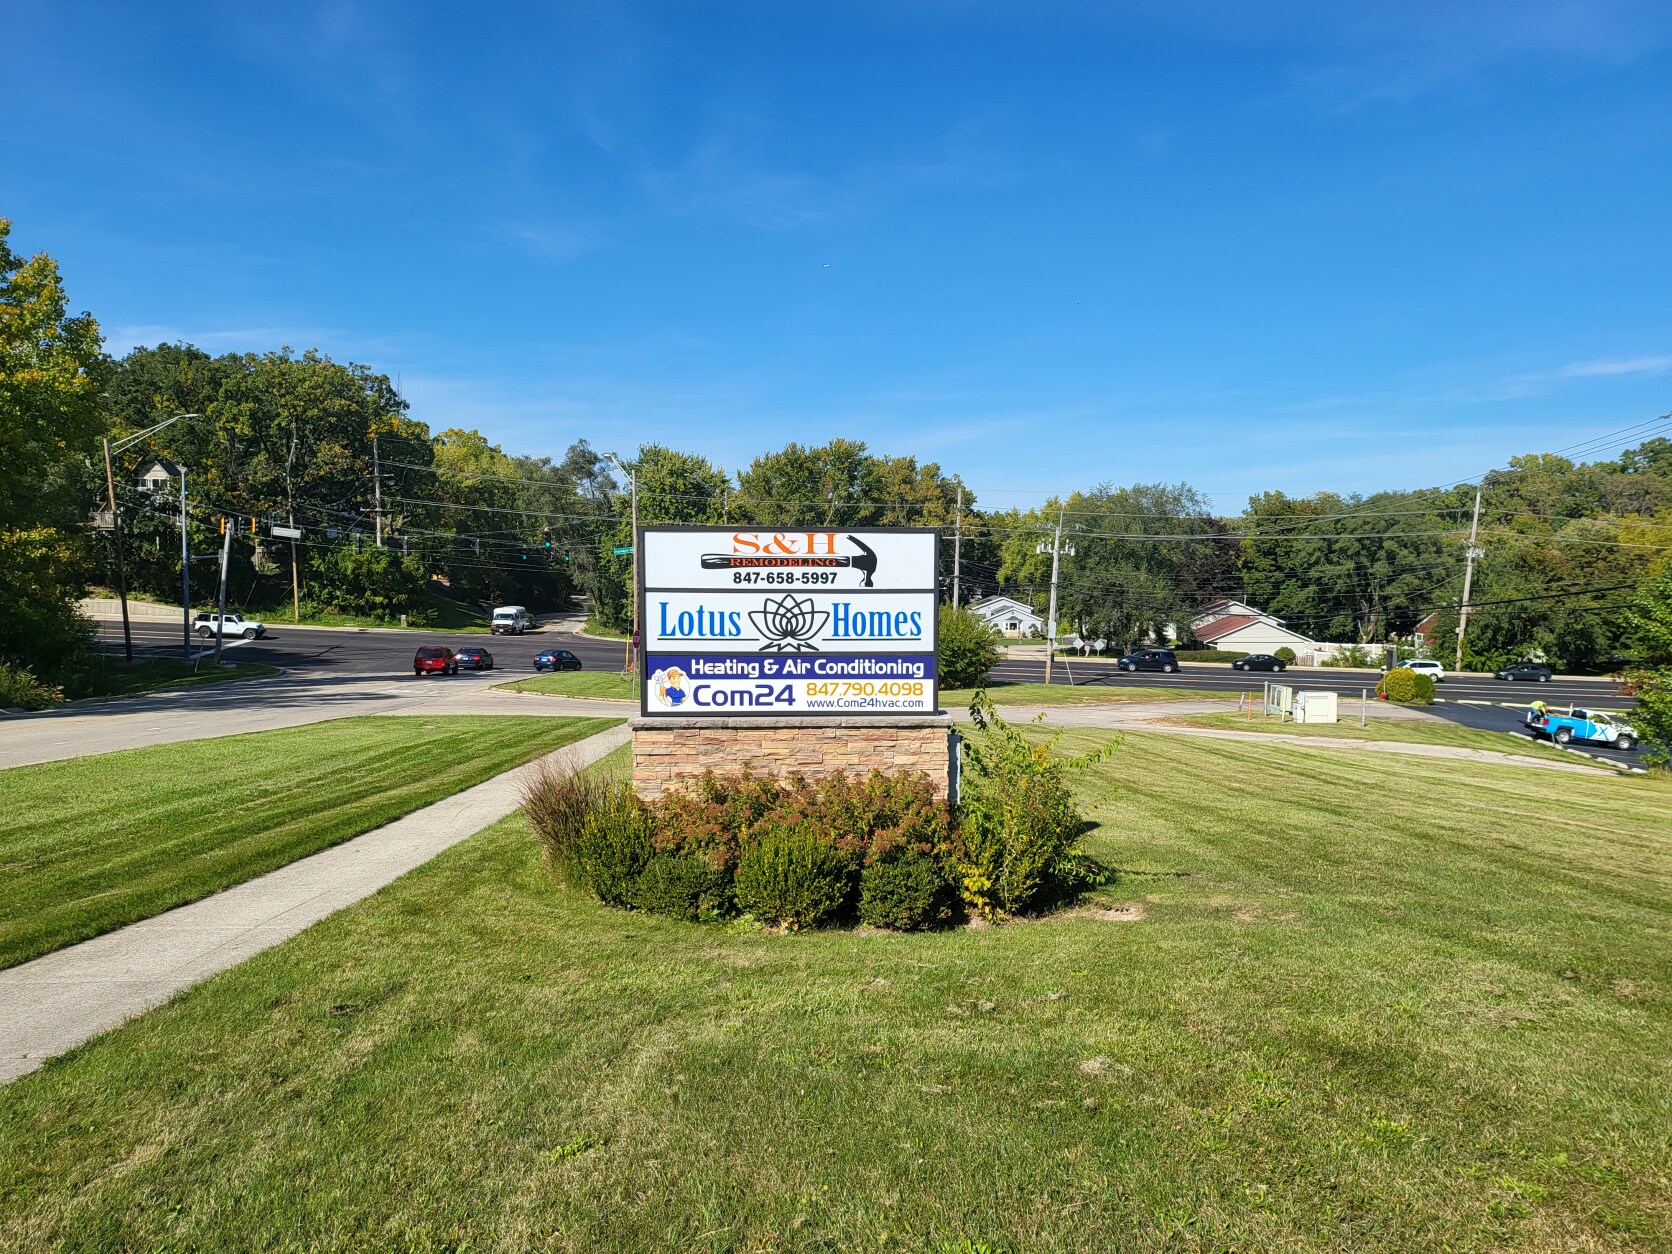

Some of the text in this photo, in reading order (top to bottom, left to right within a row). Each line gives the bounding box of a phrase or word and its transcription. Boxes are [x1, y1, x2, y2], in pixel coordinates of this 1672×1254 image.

[733, 532, 837, 554] S&H
[730, 558, 837, 567] REMODELING
[733, 572, 837, 584] 847-658-5997
[659, 602, 921, 636] Lotus Homes
[691, 659, 924, 677] Heating & Air Conditioning
[693, 684, 796, 706] Com24
[806, 682, 924, 696] 847.790.4098
[806, 697, 924, 708] www.Com24hvac.com
